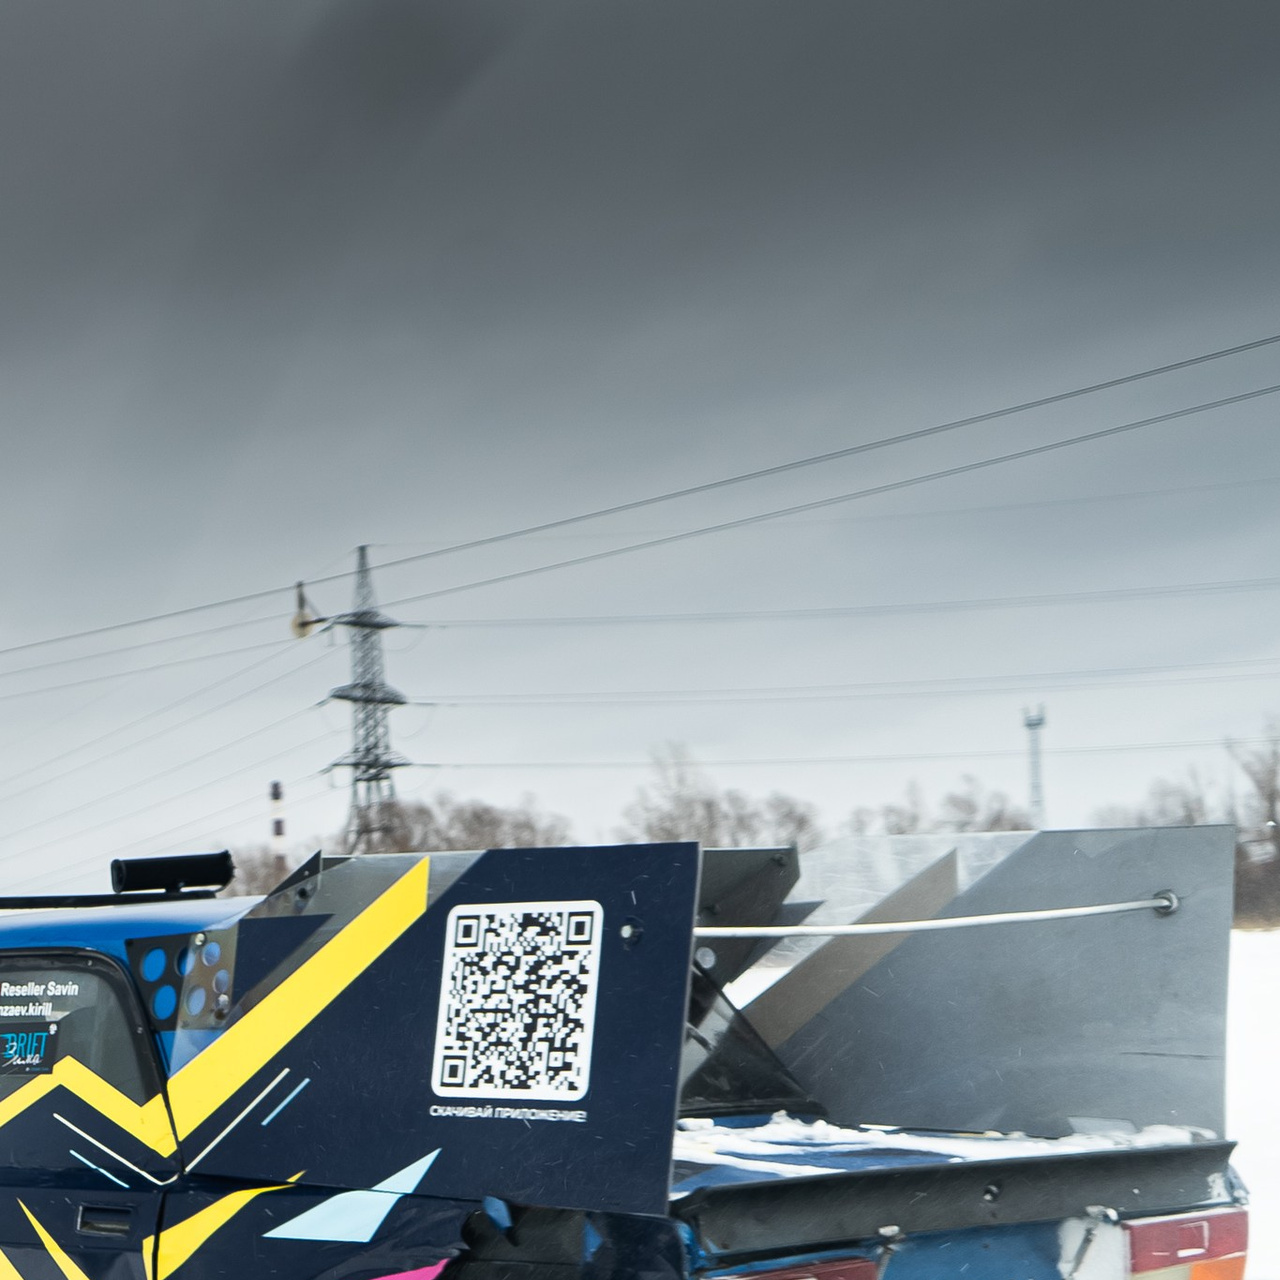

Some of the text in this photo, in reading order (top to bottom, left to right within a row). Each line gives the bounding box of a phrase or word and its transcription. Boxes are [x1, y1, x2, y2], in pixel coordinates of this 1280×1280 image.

[0, 980, 79, 997] Reseller Savin
[429, 1105, 493, 1118] СКАЧИВАЙ
